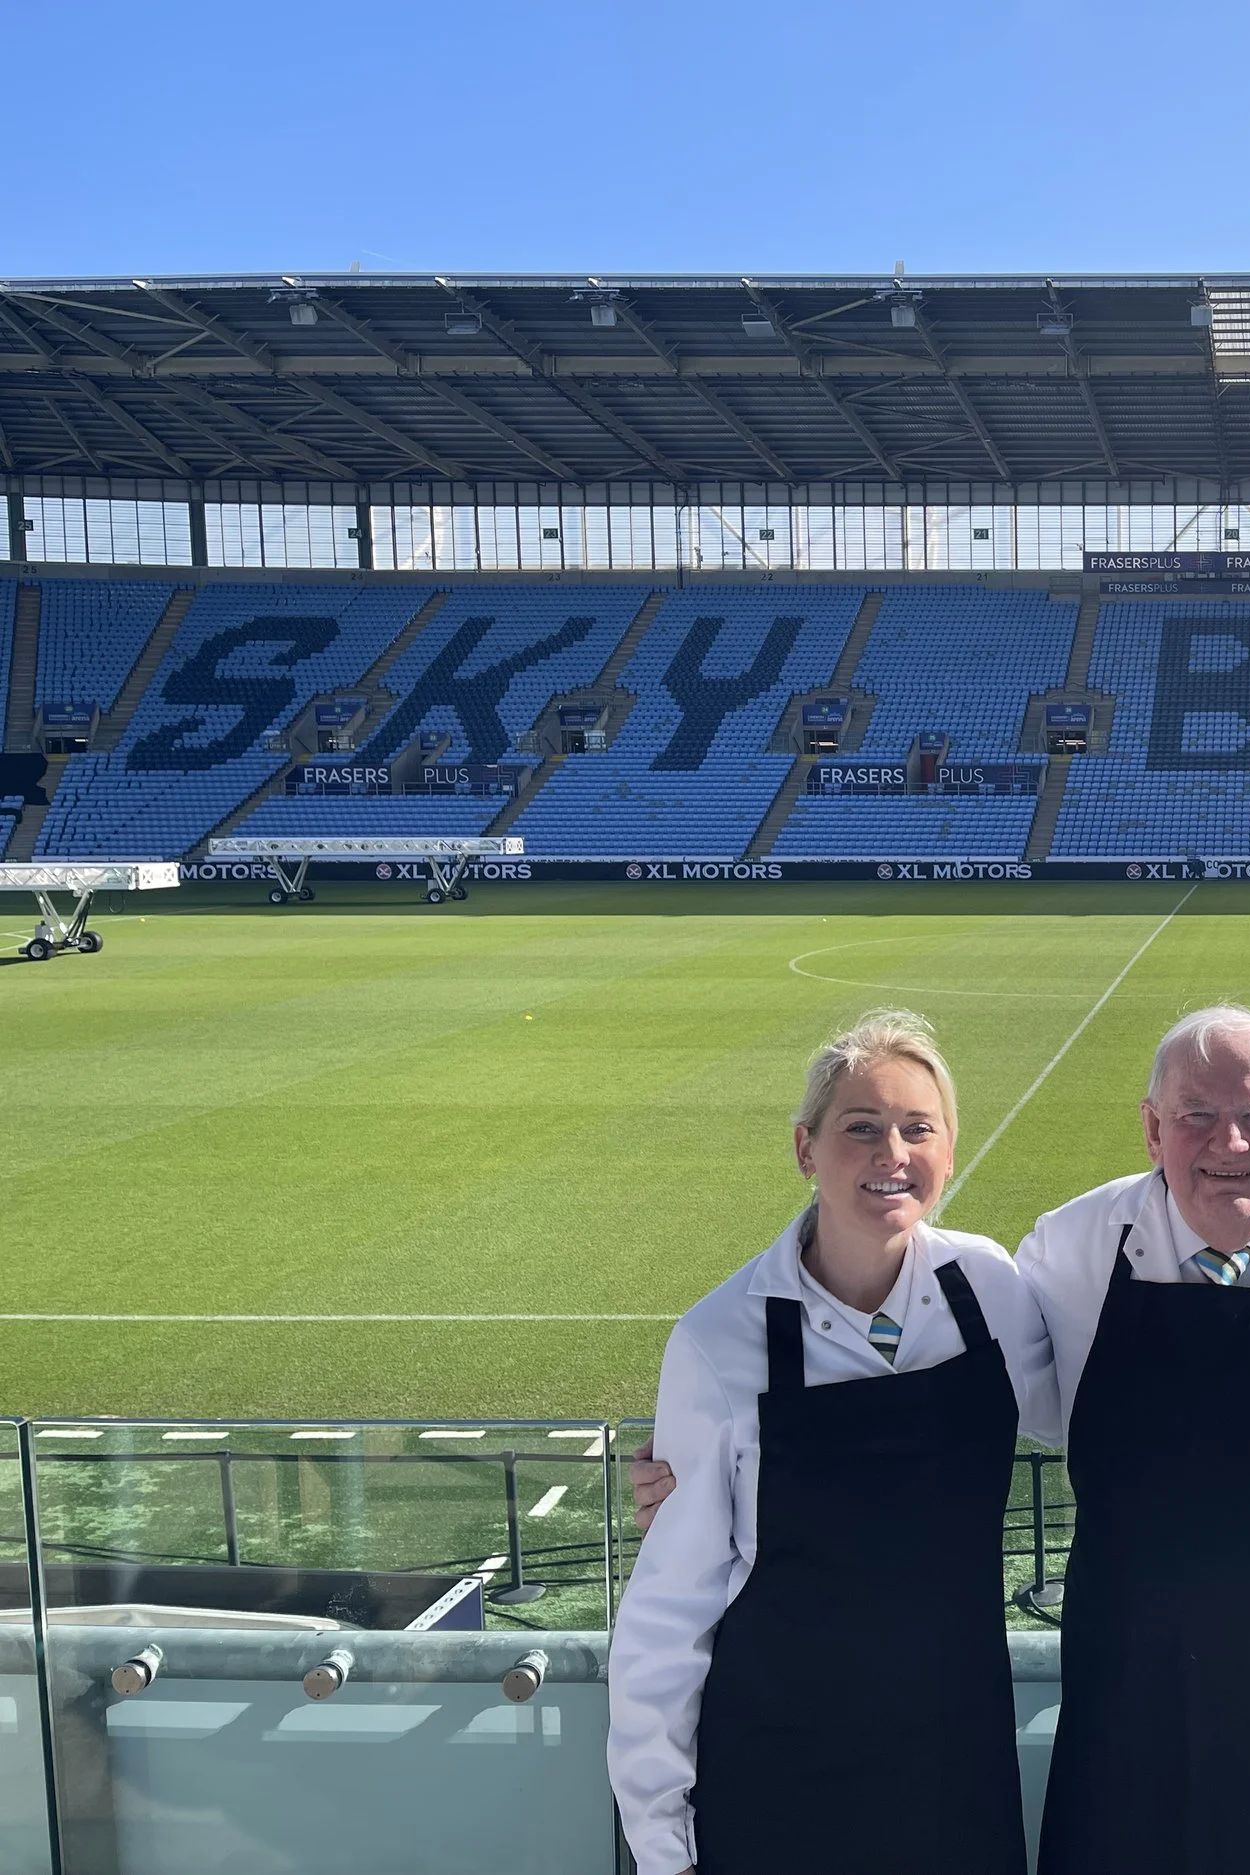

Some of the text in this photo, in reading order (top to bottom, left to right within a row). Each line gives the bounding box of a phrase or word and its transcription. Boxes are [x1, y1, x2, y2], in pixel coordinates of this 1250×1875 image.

[17, 520, 32, 531] 25
[350, 529, 362, 538] 24
[545, 529, 557, 538] 23
[761, 530, 773, 539] 22
[975, 529, 987, 539] 21
[1226, 530, 1238, 539] 20
[1091, 557, 1181, 569] FRASERSPLUS
[22, 564, 37, 574] 25
[761, 573, 773, 581] 22
[976, 573, 988, 581] 21
[1108, 583, 1179, 593] FRASERSPLUS
[126, 616, 804, 771] SKY
[304, 768, 470, 783] FRASERS PLUS
[820, 768, 984, 783] FRASERS PLUS
[397, 864, 532, 879] XL MOTORS
[647, 864, 783, 879] XL MOTORS
[897, 864, 926, 879] XL
[1146, 864, 1175, 879] XL
